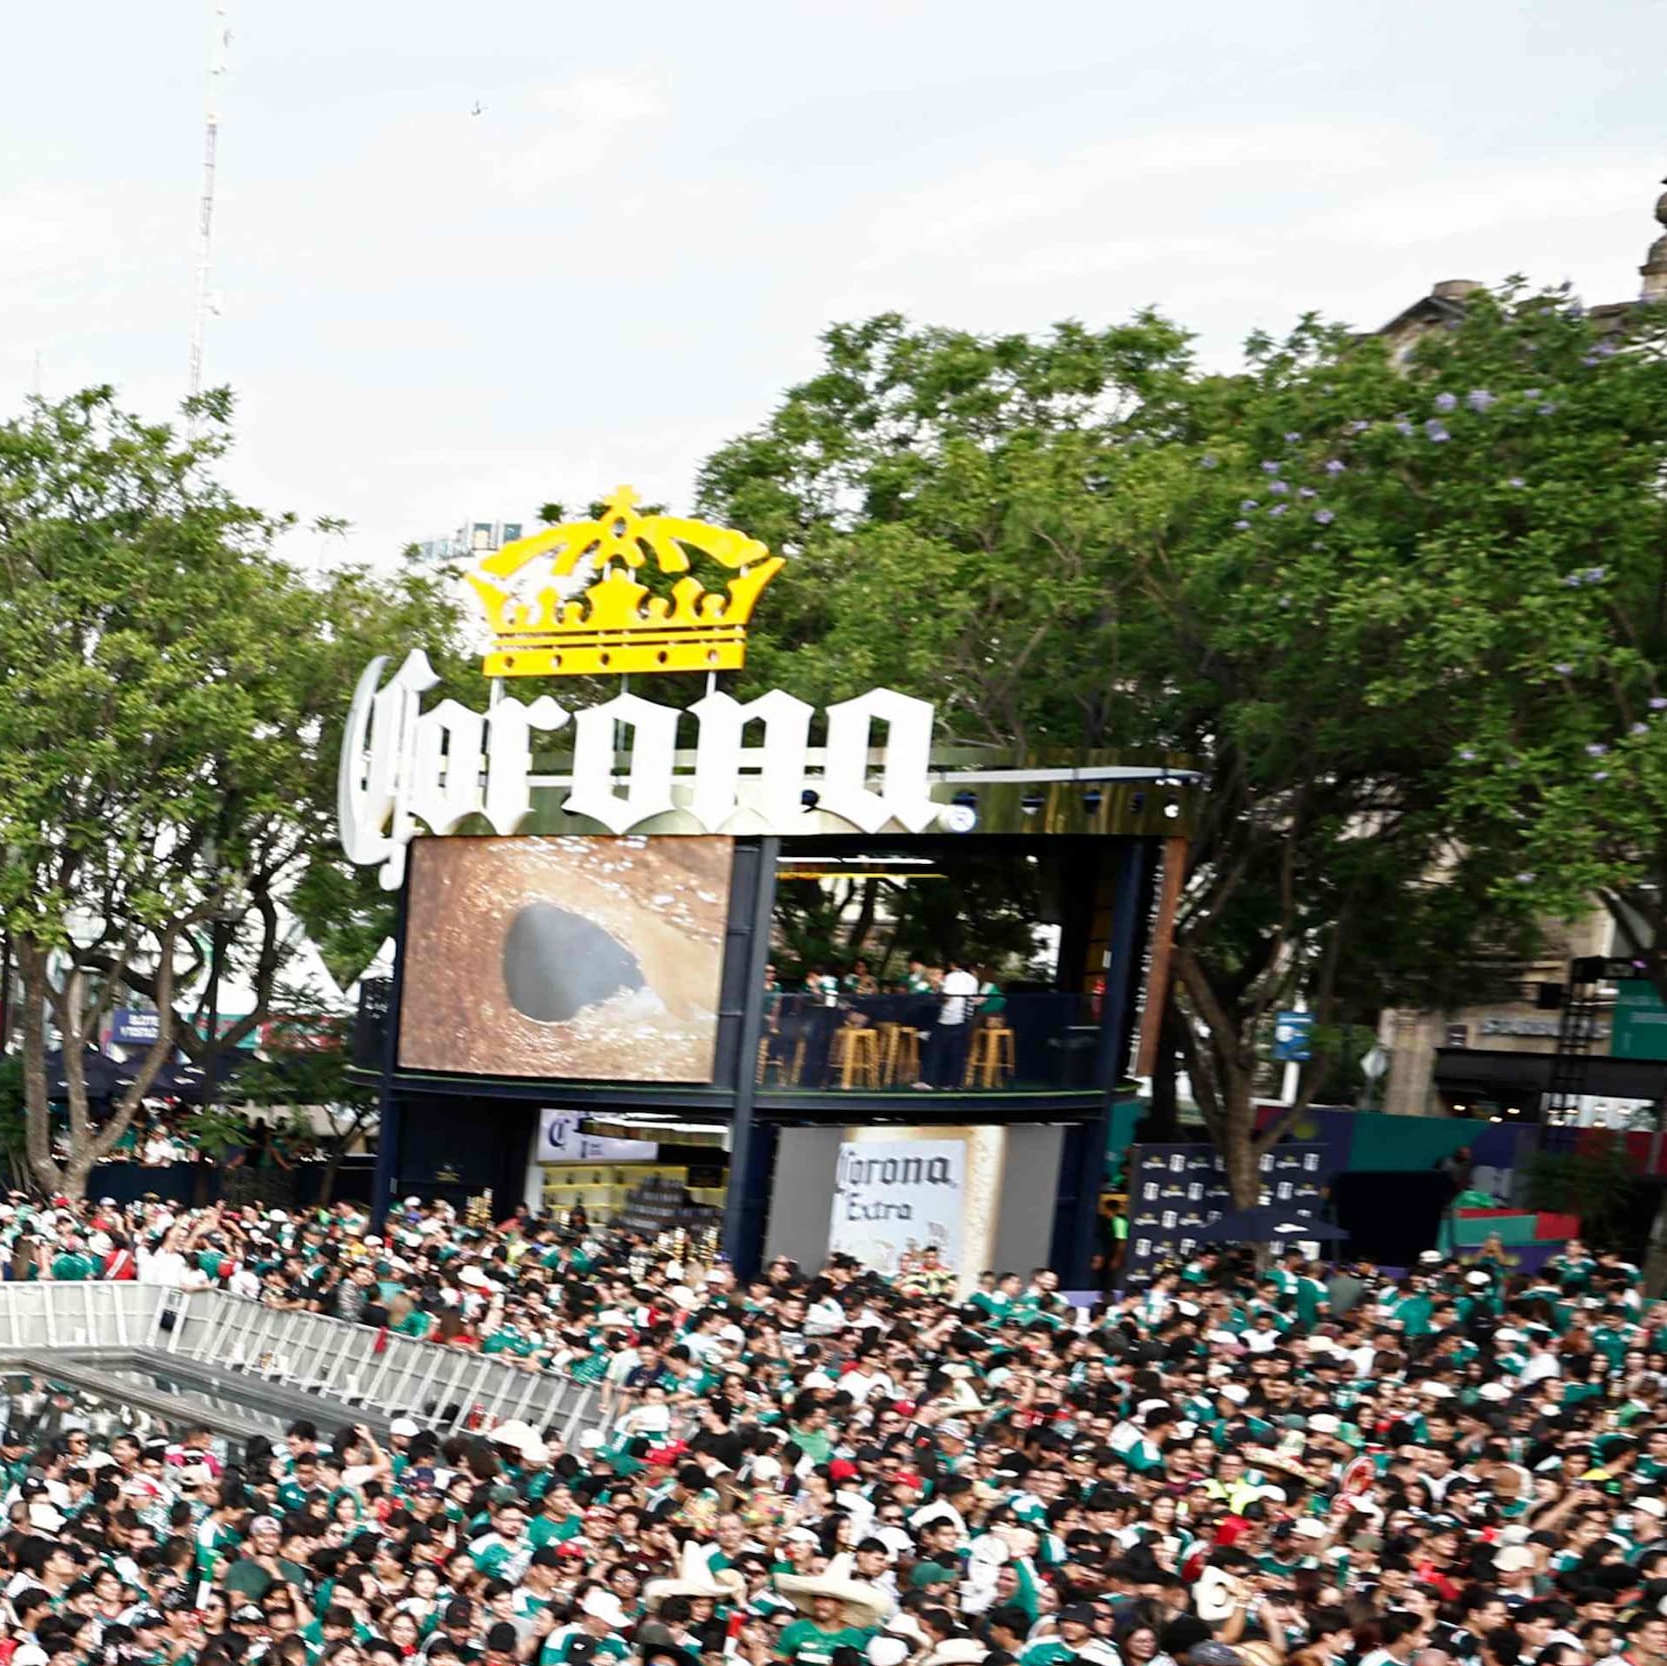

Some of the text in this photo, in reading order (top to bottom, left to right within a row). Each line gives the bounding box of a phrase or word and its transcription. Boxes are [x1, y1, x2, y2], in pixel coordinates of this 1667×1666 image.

[338, 648, 947, 890] Corona
[835, 1151, 951, 1192] Corona
[847, 1193, 913, 1221] Extra
